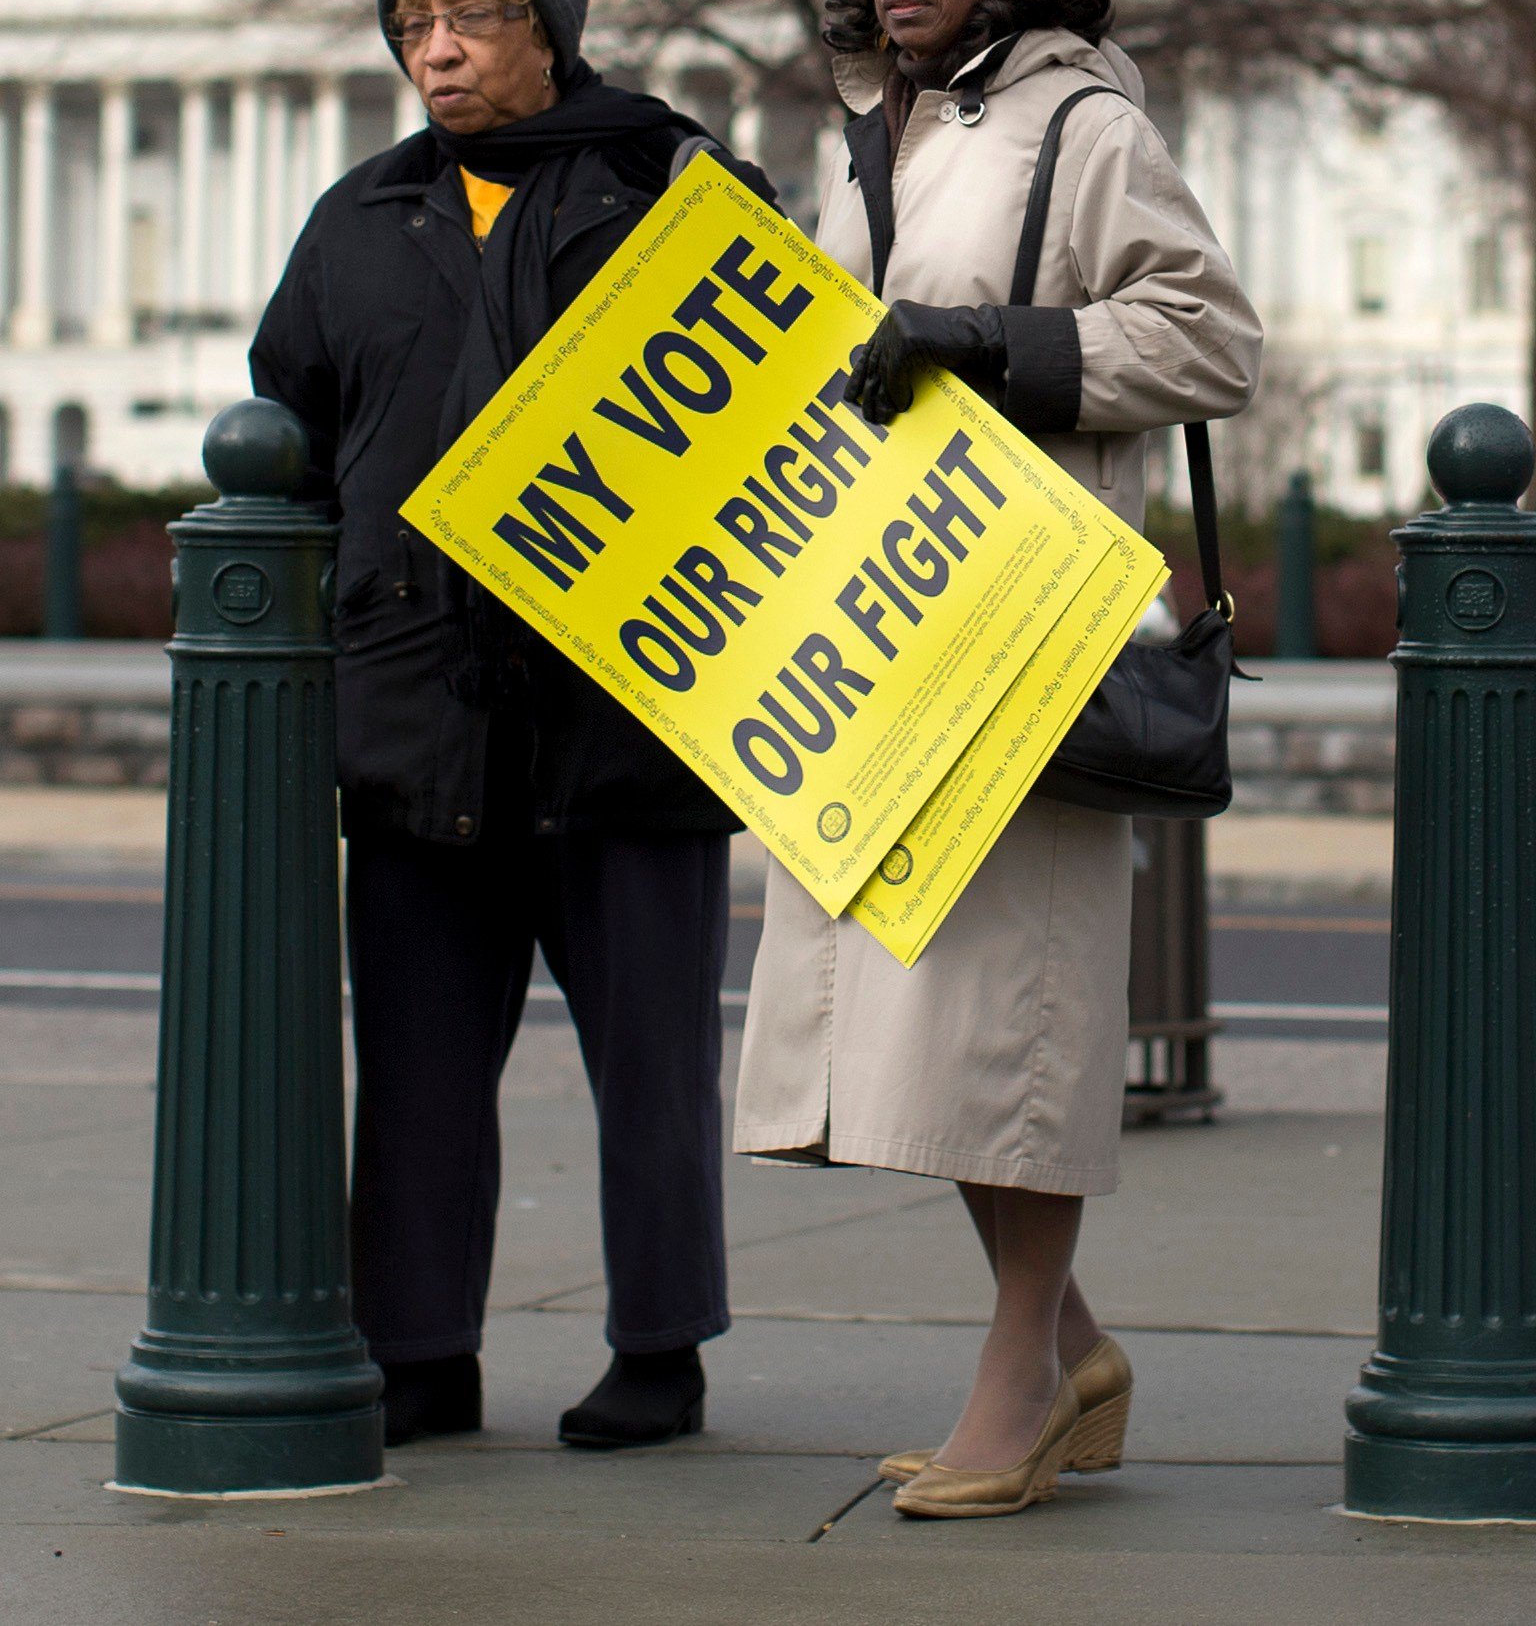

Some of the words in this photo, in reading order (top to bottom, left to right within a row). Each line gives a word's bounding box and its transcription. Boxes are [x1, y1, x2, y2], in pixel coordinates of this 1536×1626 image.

[723, 184, 753, 213] Human
[752, 207, 778, 234] Rights
[784, 233, 809, 262] Voting
[807, 254, 834, 281] Rights
[838, 280, 873, 315] Women's
[441, 470, 470, 495] Voting
[462, 445, 489, 471] Rights
[487, 404, 523, 440] Women's
[517, 379, 544, 406] Rights
[543, 354, 564, 374] Civil
[558, 331, 585, 358] Rights
[584, 292, 618, 326] Worker's
[612, 267, 639, 293] Rights
[638, 205, 689, 263] Environmental
[684, 181, 712, 209] Rights
[492, 431, 634, 592] MY
[592, 234, 814, 457] VOTE
[931, 373, 958, 403] Worker's
[956, 397, 977, 423] Rights
[980, 421, 1025, 469] Environmental
[1021, 463, 1043, 489] Rights
[1045, 488, 1070, 516] Human
[1068, 510, 1088, 545] Rights
[431, 509, 455, 541] Rights
[619, 546, 763, 692] OUR
[715, 343, 890, 577] RIGHT
[454, 536, 484, 565] Human
[1113, 536, 1137, 570] Rights
[488, 564, 514, 591] Rights
[1052, 554, 1078, 579] Voting
[1034, 578, 1058, 606] Rights
[1102, 580, 1128, 606] Voting
[511, 586, 568, 637] Environmental
[733, 634, 875, 795] OUR
[835, 429, 1006, 661] FIGHT
[1086, 606, 1109, 634] Rights
[1004, 612, 1035, 649] Women's
[572, 636, 597, 663] Rights
[985, 648, 1008, 675] Rights
[1057, 640, 1087, 679] Women's
[597, 657, 631, 692] Worker's
[635, 691, 660, 718] Rights
[967, 681, 984, 702] Civil
[1039, 679, 1061, 707] Rights
[657, 713, 676, 732] Civil
[949, 699, 971, 727] Rights
[1023, 713, 1040, 734] Civil
[679, 732, 703, 759] Rights
[919, 732, 949, 767] Worker's
[1005, 732, 1028, 760] Rights
[701, 753, 732, 788] Women's
[899, 767, 922, 794] Rights
[978, 767, 1006, 803] Worker's
[735, 788, 757, 814] Rights
[755, 807, 776, 835] Voting
[854, 798, 899, 857] Environmental
[960, 803, 982, 831] Rights
[779, 834, 800, 860] Rights
[798, 855, 823, 883] Human
[832, 854, 857, 882] Rights
[918, 836, 961, 898] Environmental
[865, 903, 889, 926] Human
[899, 895, 922, 924] Rights
